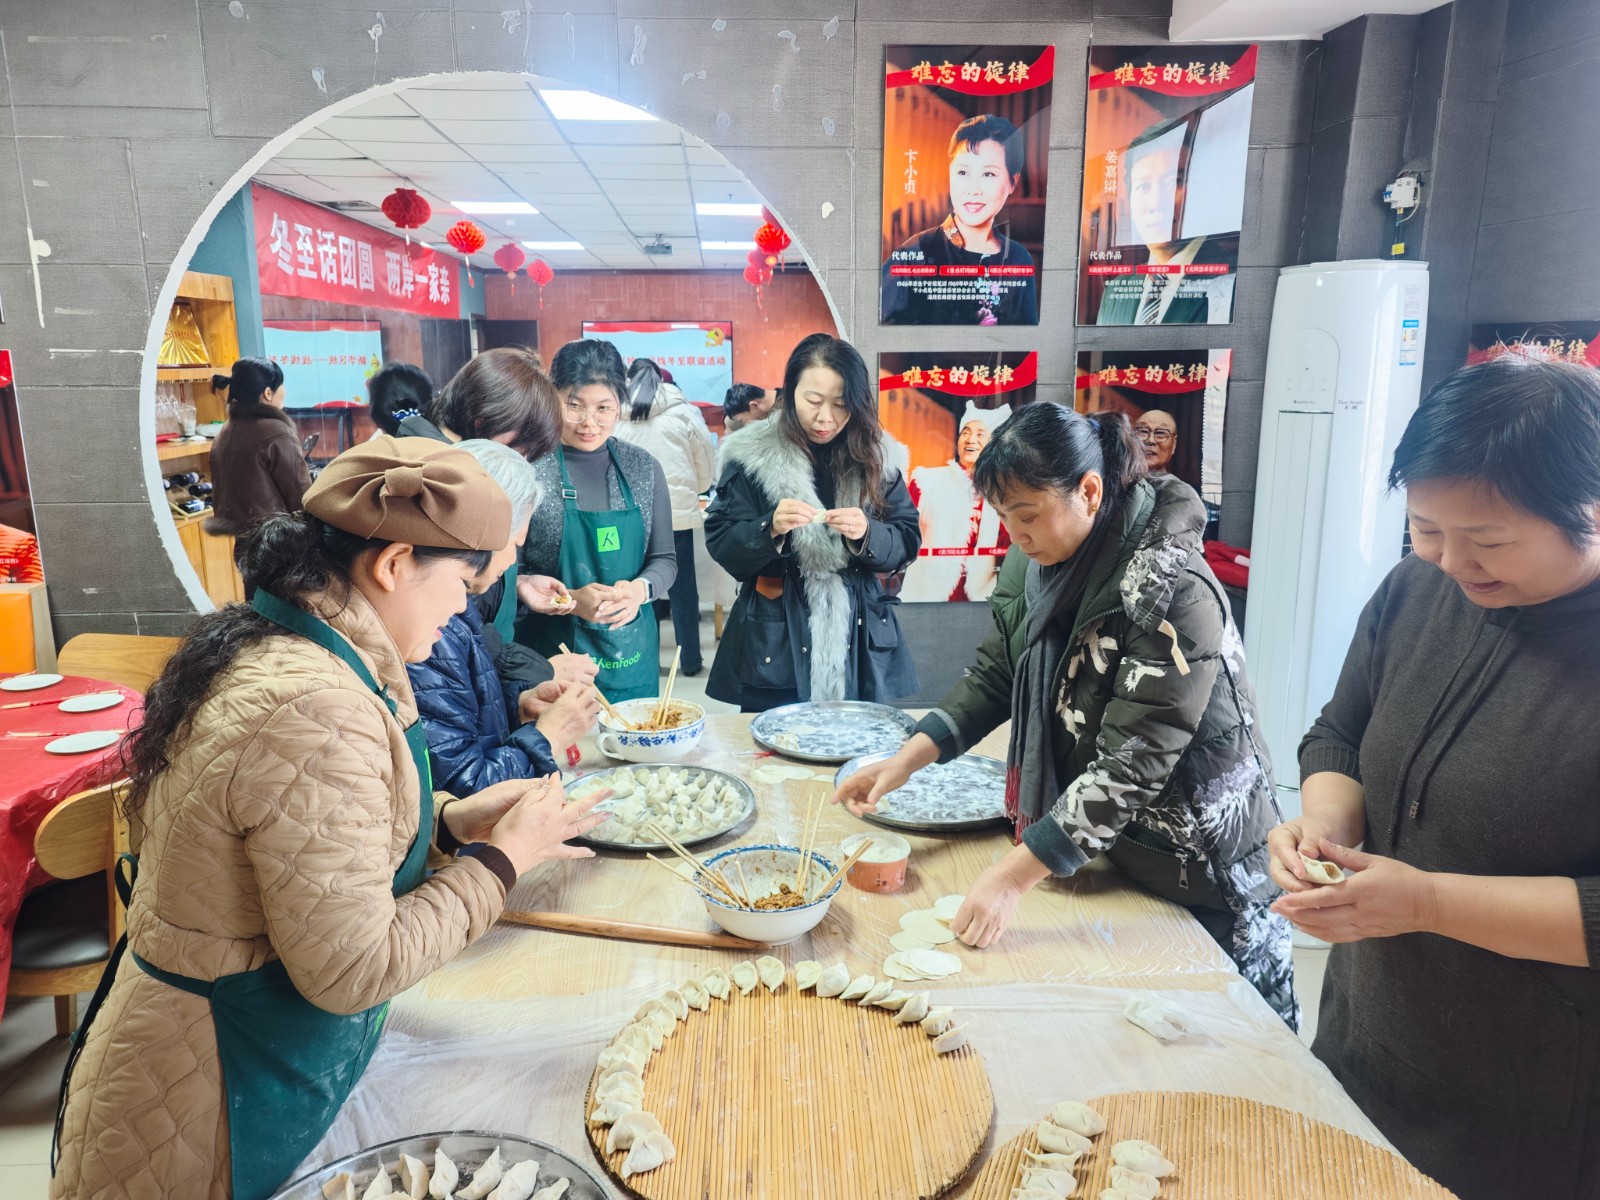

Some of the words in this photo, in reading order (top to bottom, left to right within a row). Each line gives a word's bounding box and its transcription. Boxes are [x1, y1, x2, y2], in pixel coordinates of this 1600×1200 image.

[911, 60, 1031, 85] 难忘的旋律
[1114, 61, 1231, 86] 难忘的旋律
[904, 149, 919, 195] 卞小贞
[269, 212, 376, 293] 冬至话团圆
[385, 250, 451, 306] 两岸一家亲
[891, 251, 925, 261] 代表作品
[1089, 250, 1122, 261] 代表作品
[902, 365, 1015, 387] 难忘的旋律
[1099, 363, 1207, 384] 难忘的旋律
